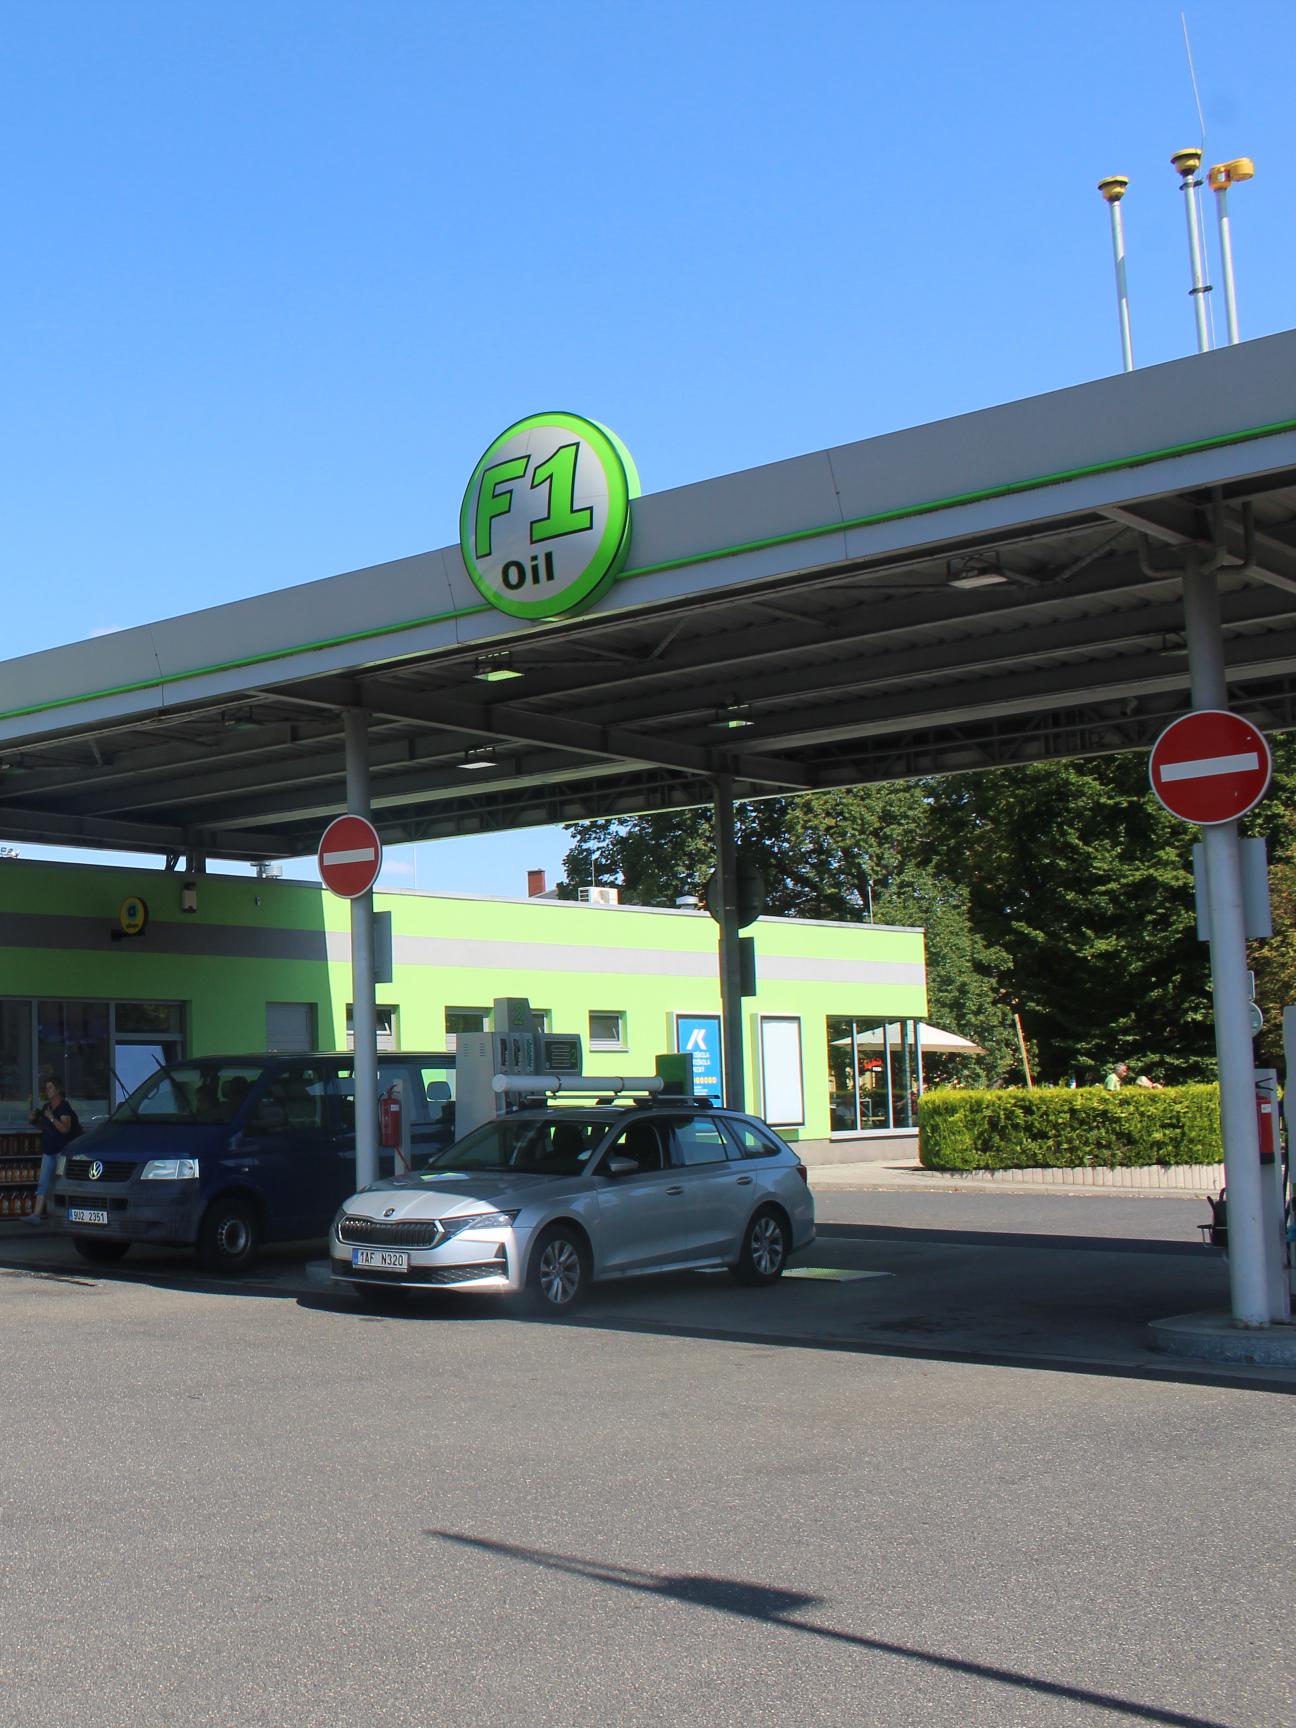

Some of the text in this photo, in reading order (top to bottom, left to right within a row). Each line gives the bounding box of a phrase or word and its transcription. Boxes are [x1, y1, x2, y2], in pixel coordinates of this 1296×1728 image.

[475, 441, 594, 560] F1
[512, 1003, 525, 1025] 2
[89, 1211, 104, 1222] 2351
[361, 1251, 404, 1266] 1AF N320
